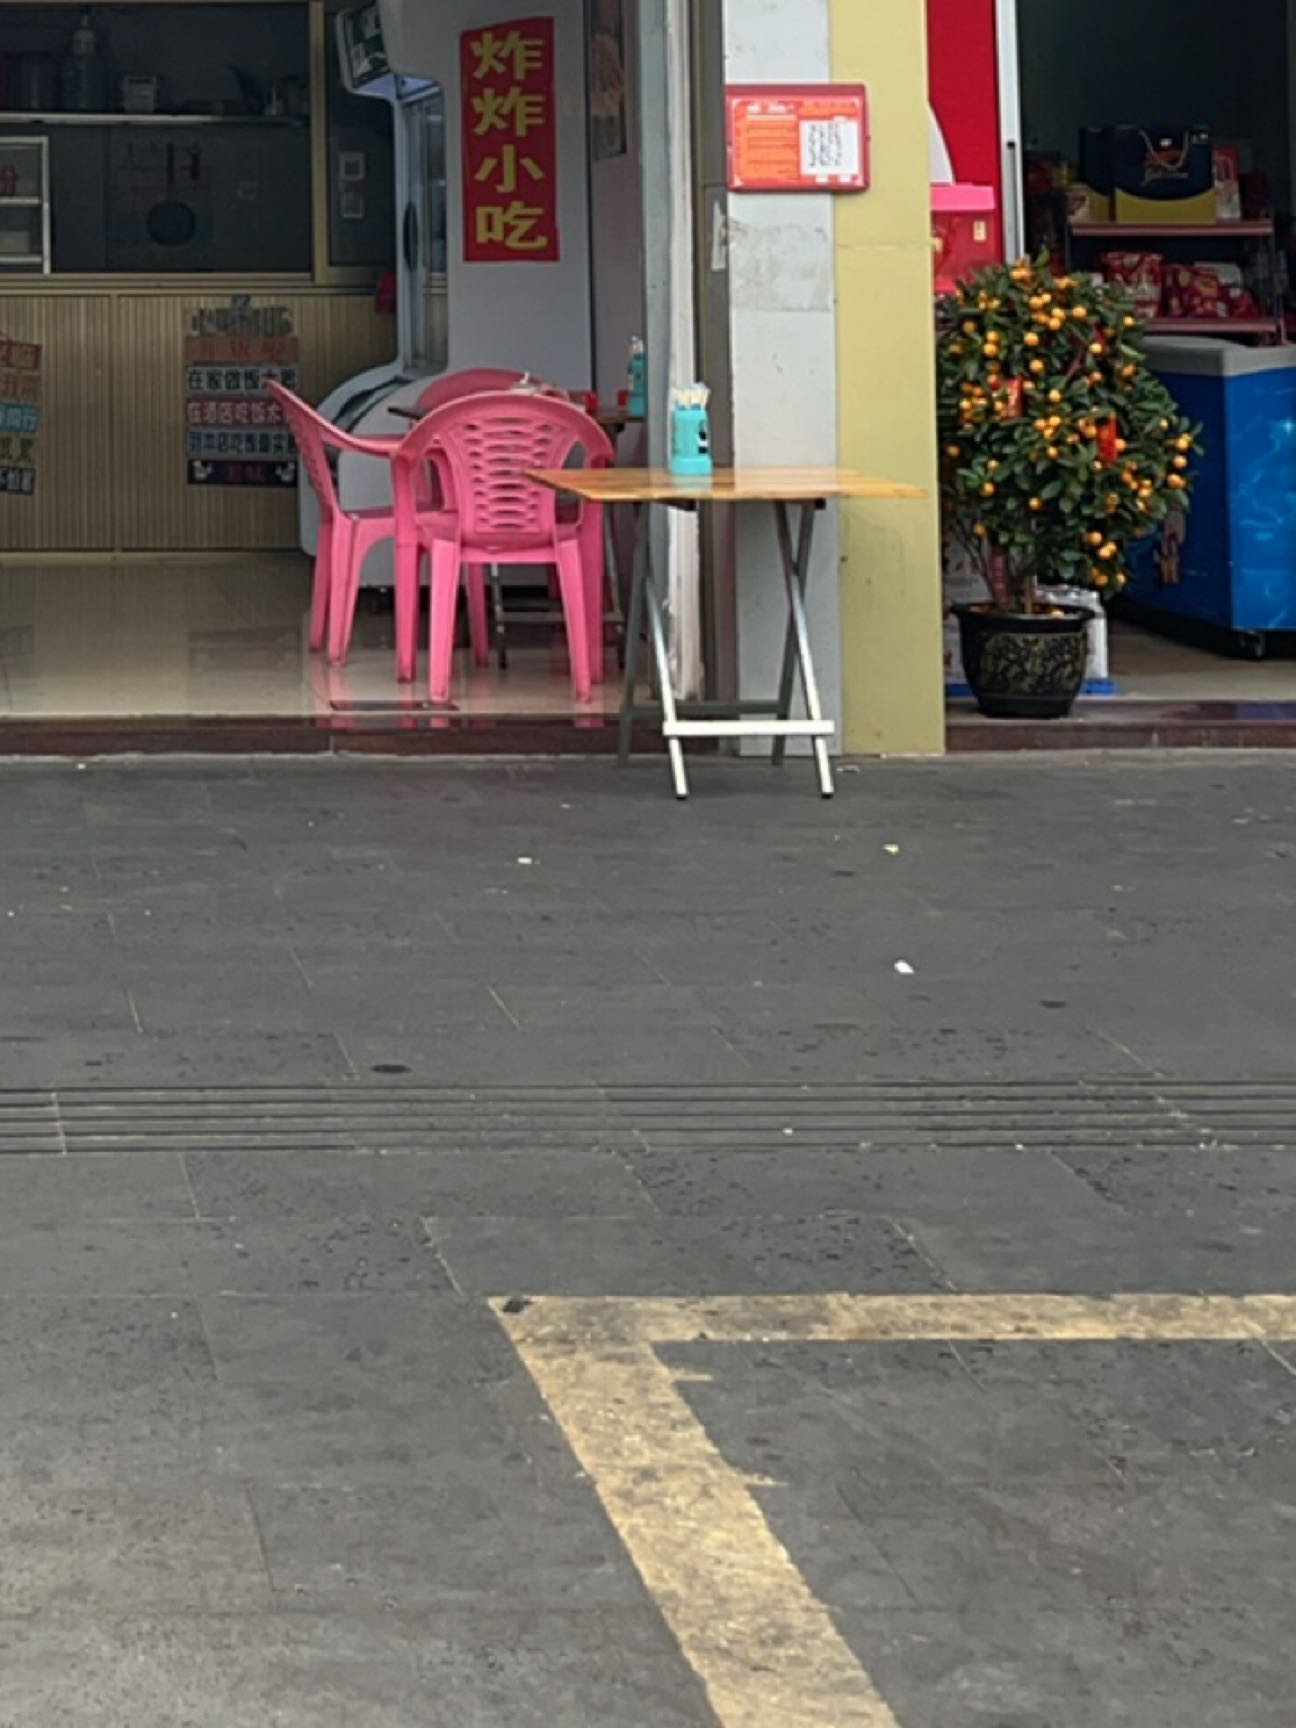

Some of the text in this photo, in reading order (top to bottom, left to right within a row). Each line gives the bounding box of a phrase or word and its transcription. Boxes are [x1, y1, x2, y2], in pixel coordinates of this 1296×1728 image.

[469, 30, 548, 251] 炸炸小吃
[188, 401, 288, 424] 在酒店吃饭太
